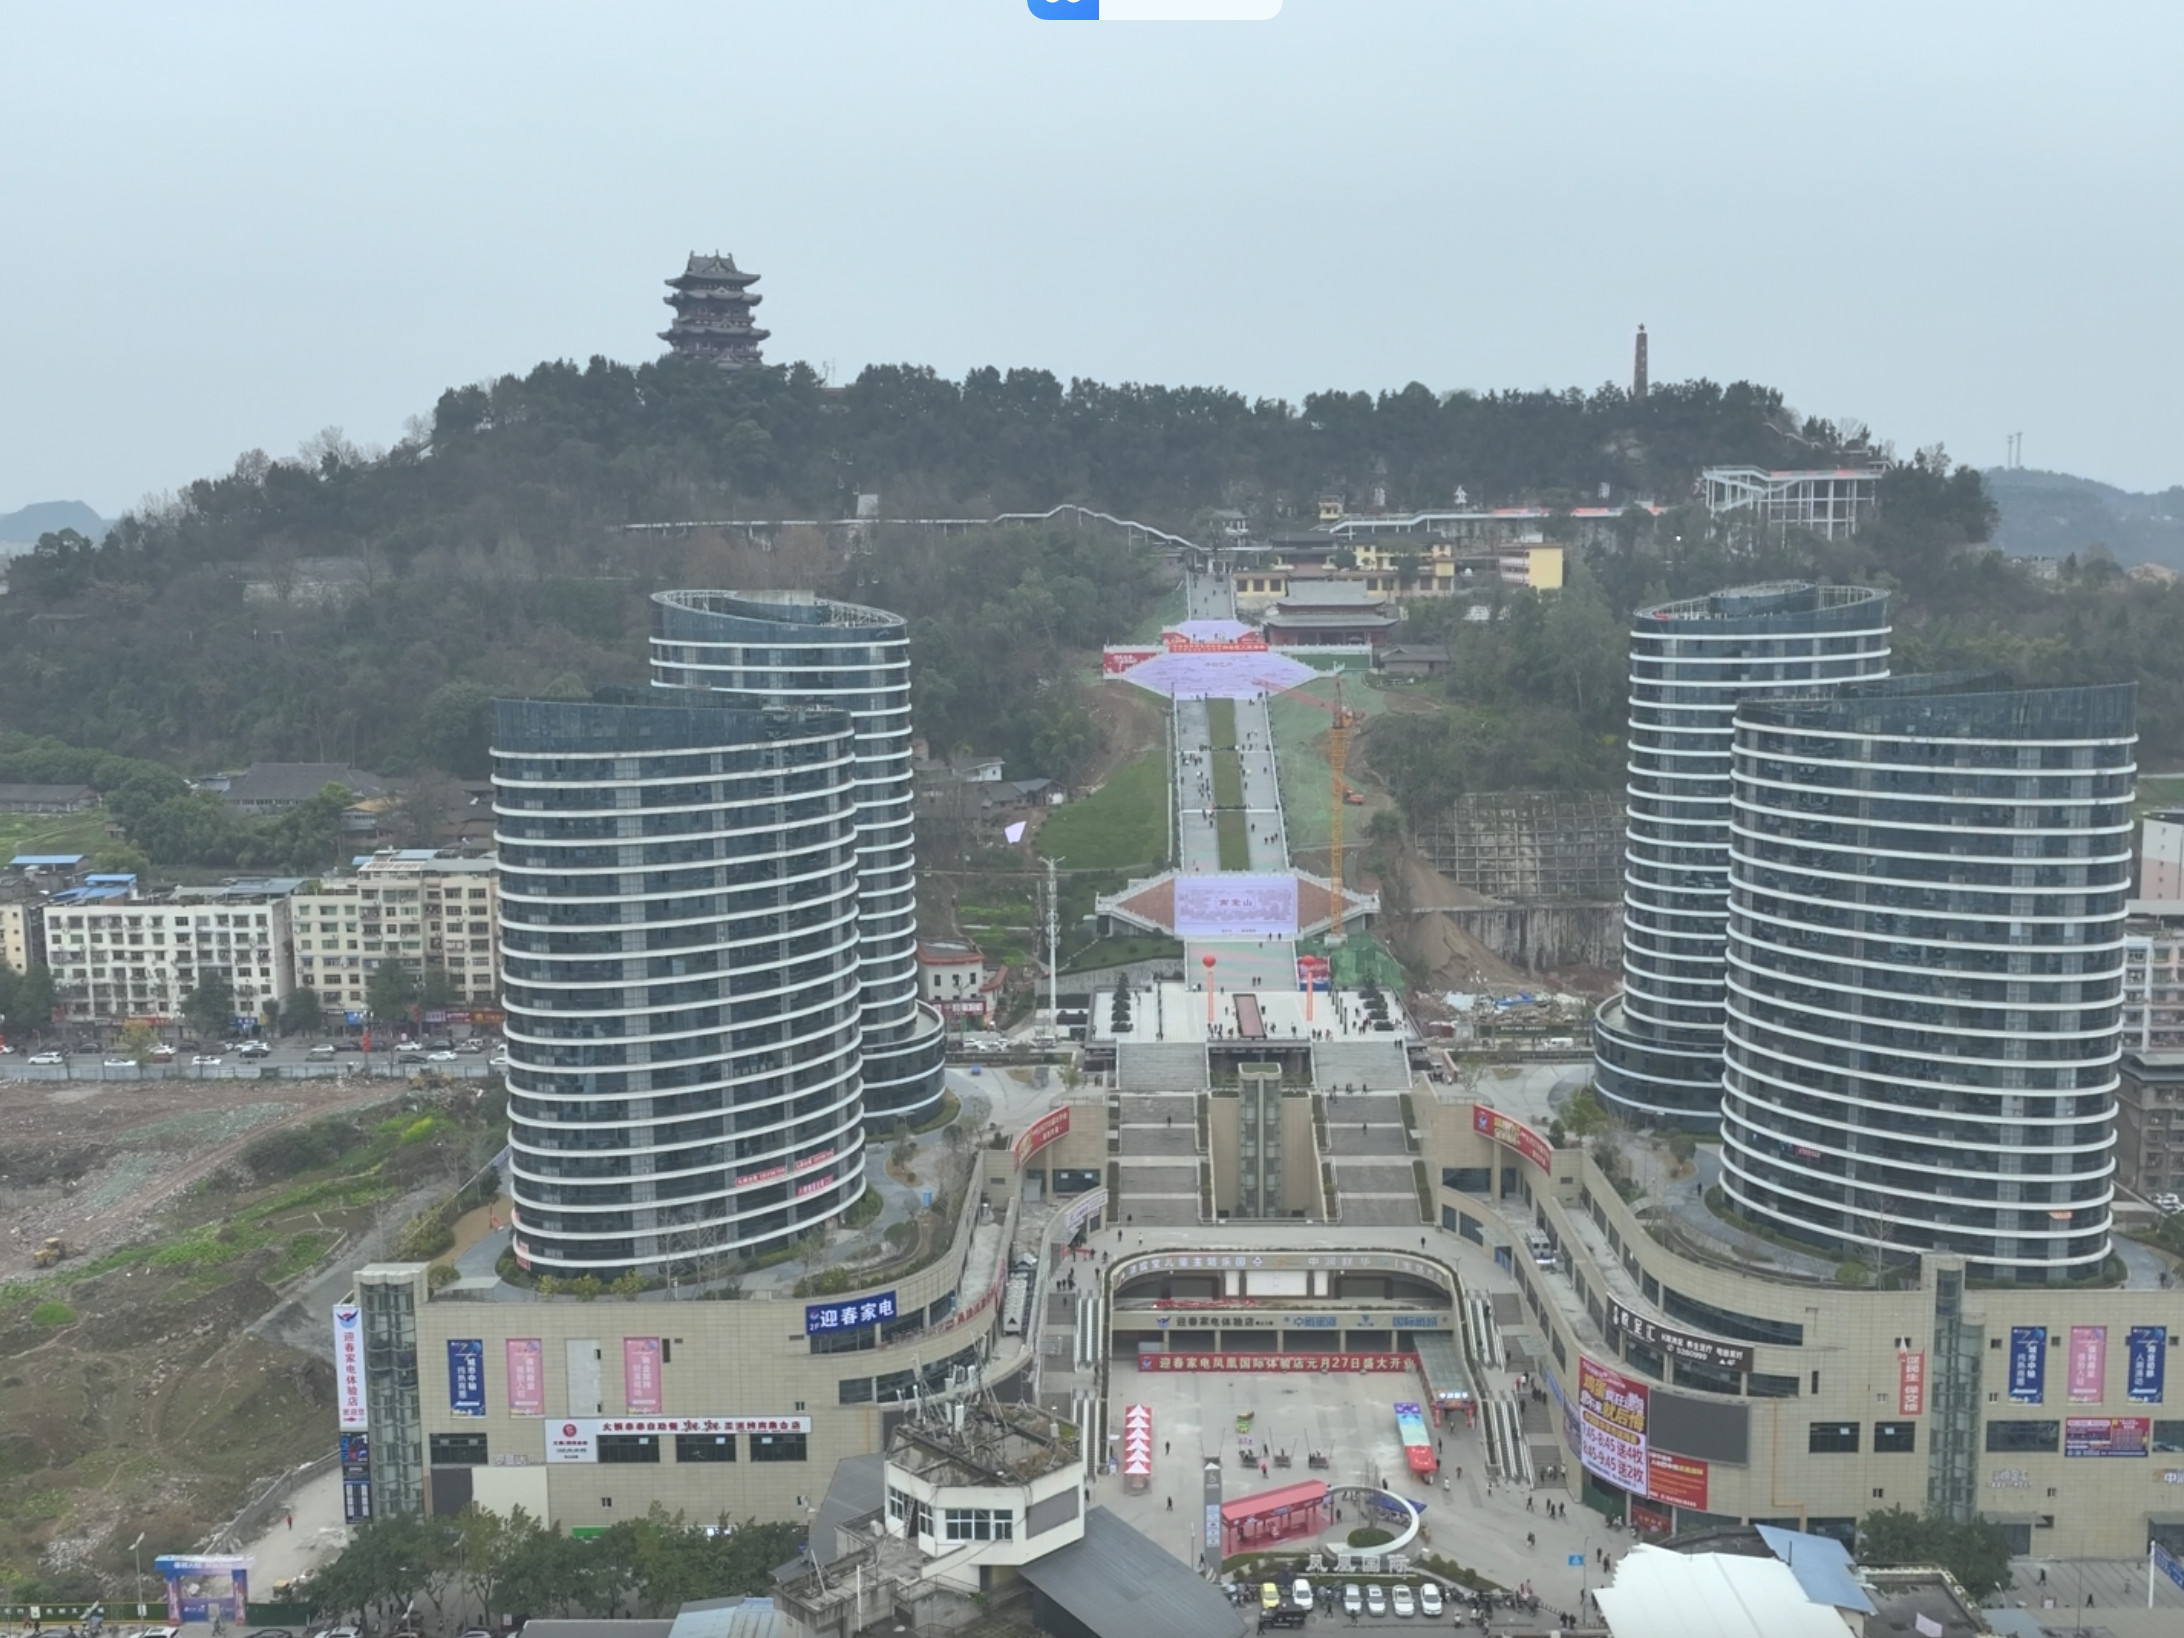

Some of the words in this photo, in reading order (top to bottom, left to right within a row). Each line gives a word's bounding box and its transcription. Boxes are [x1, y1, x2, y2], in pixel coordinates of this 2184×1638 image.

[820, 1299, 894, 1327] 迎春家电
[1176, 1316, 1255, 1327] 迎春家电体验店
[344, 1331, 358, 1407] 迎春家电体验店
[1305, 1553, 1411, 1574] 凤凰国际
